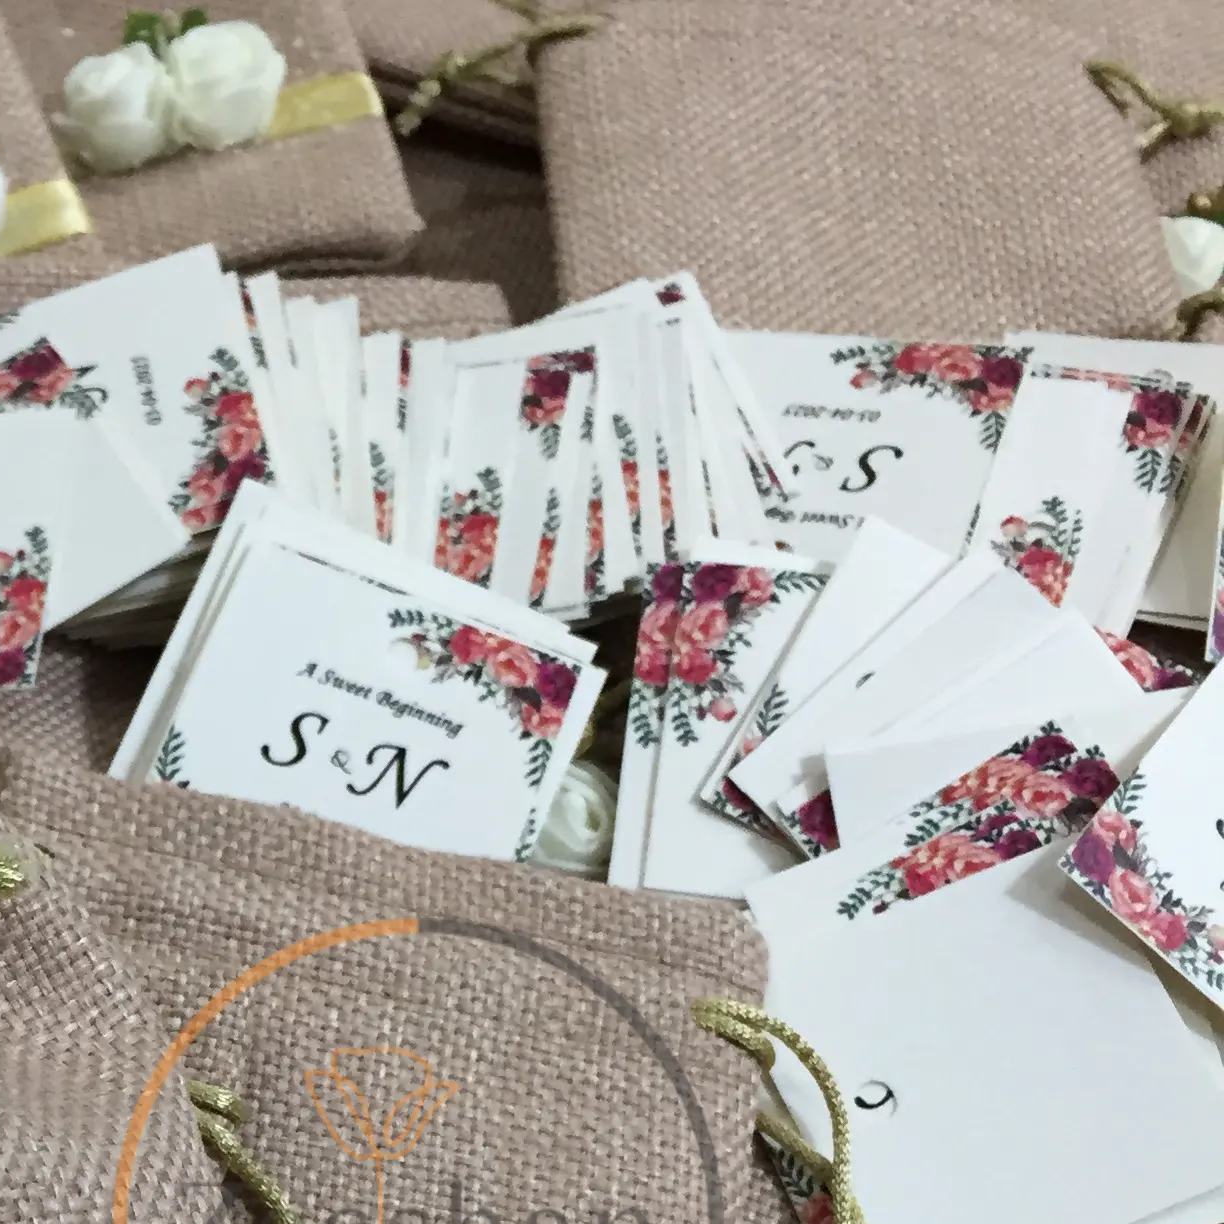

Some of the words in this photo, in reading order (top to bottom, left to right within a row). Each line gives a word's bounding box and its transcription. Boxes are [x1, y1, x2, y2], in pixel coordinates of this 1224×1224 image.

[296, 662, 318, 678] A
[317, 669, 372, 699] Sweet
[376, 690, 464, 739] Beginning
